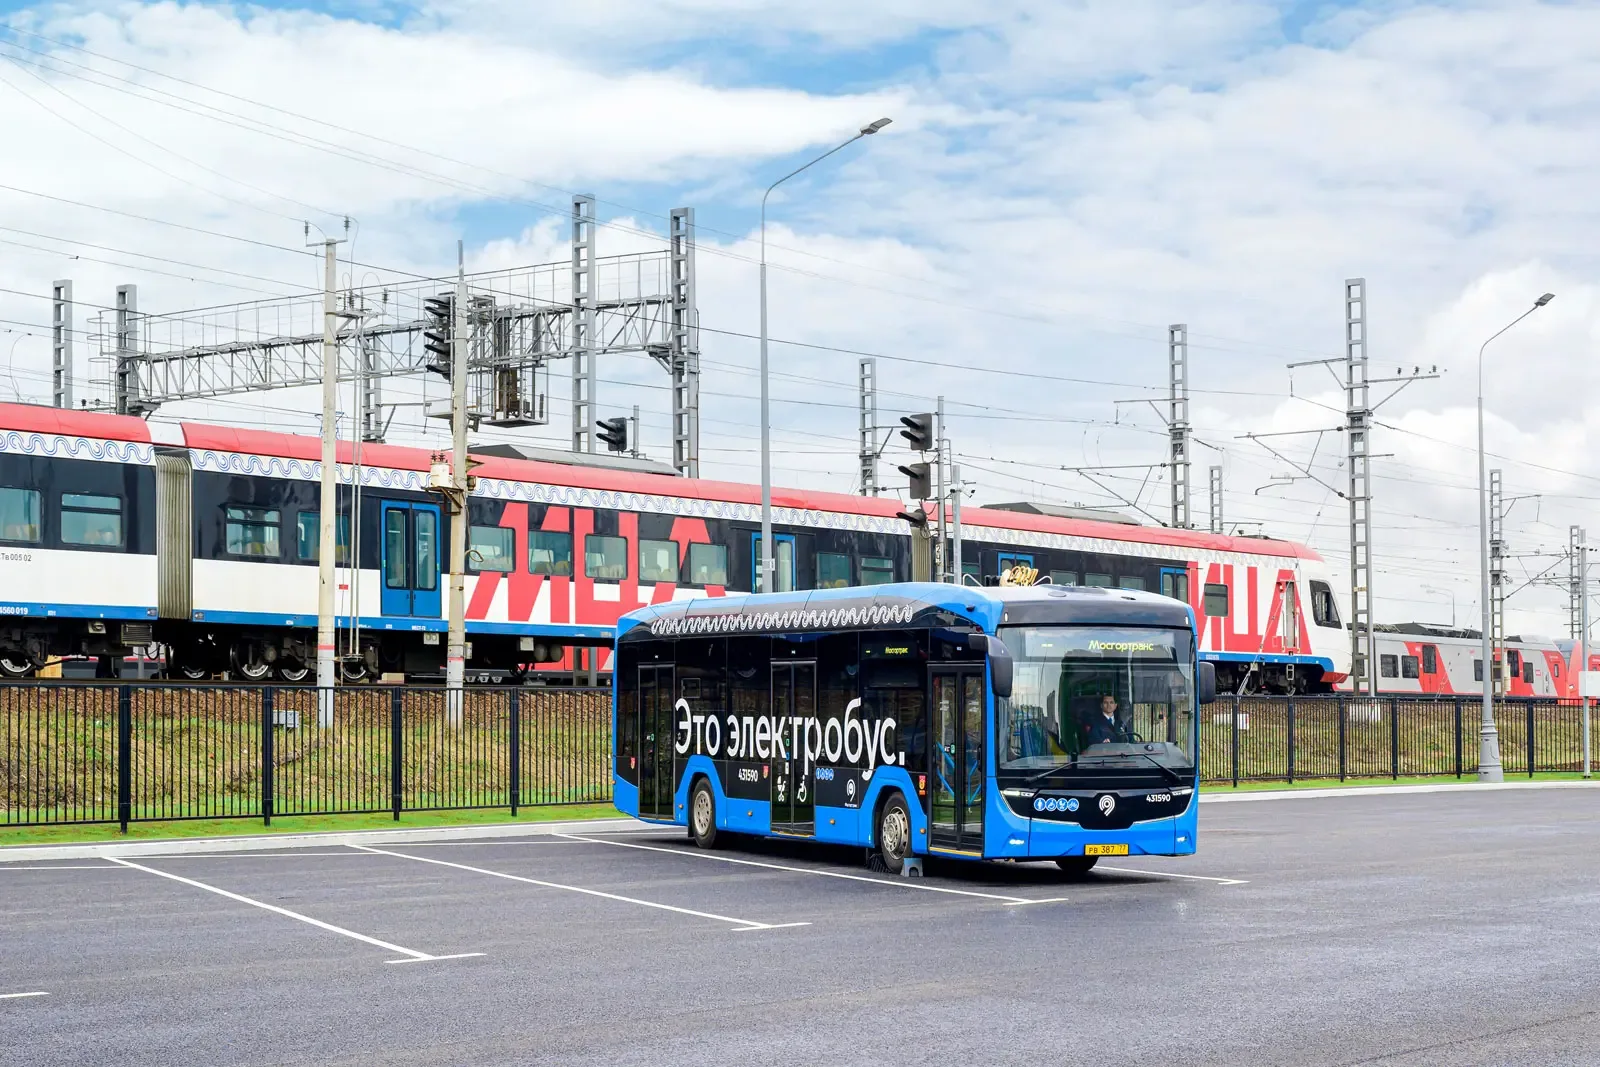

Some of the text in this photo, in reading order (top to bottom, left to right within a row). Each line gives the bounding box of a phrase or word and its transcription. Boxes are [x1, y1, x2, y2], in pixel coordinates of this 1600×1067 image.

[1088, 640, 1154, 652] Мосгортранс
[675, 697, 905, 781] Это электробус.
[738, 768, 759, 782] 431590
[1146, 794, 1171, 802] 431590
[1101, 845, 1115, 854] 387
